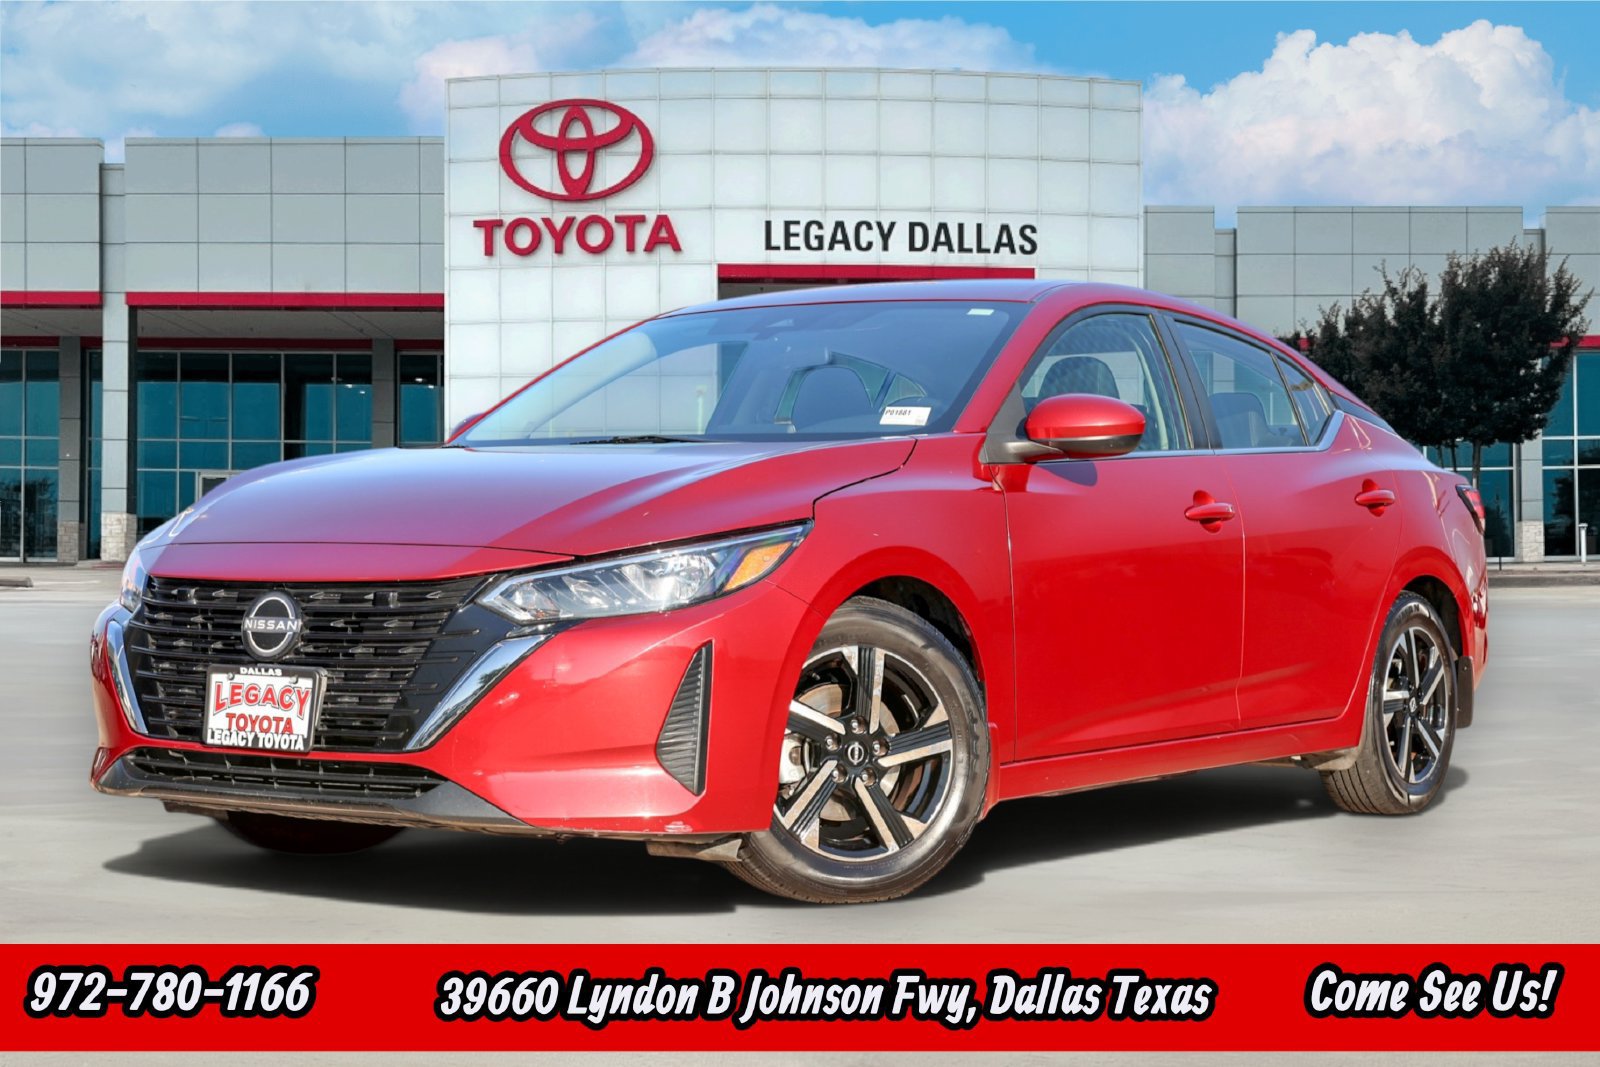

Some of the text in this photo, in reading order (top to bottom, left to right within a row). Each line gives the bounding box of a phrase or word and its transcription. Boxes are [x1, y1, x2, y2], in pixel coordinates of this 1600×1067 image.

[474, 214, 683, 258] TOYOTA
[764, 219, 1039, 256] LEGACY DALLAS
[244, 620, 298, 631] NISSAN
[240, 667, 282, 676] DALLAS
[214, 681, 312, 719] LEGACY
[226, 713, 294, 734] TOYOTA
[207, 728, 304, 750] LEGACY TOYOTA
